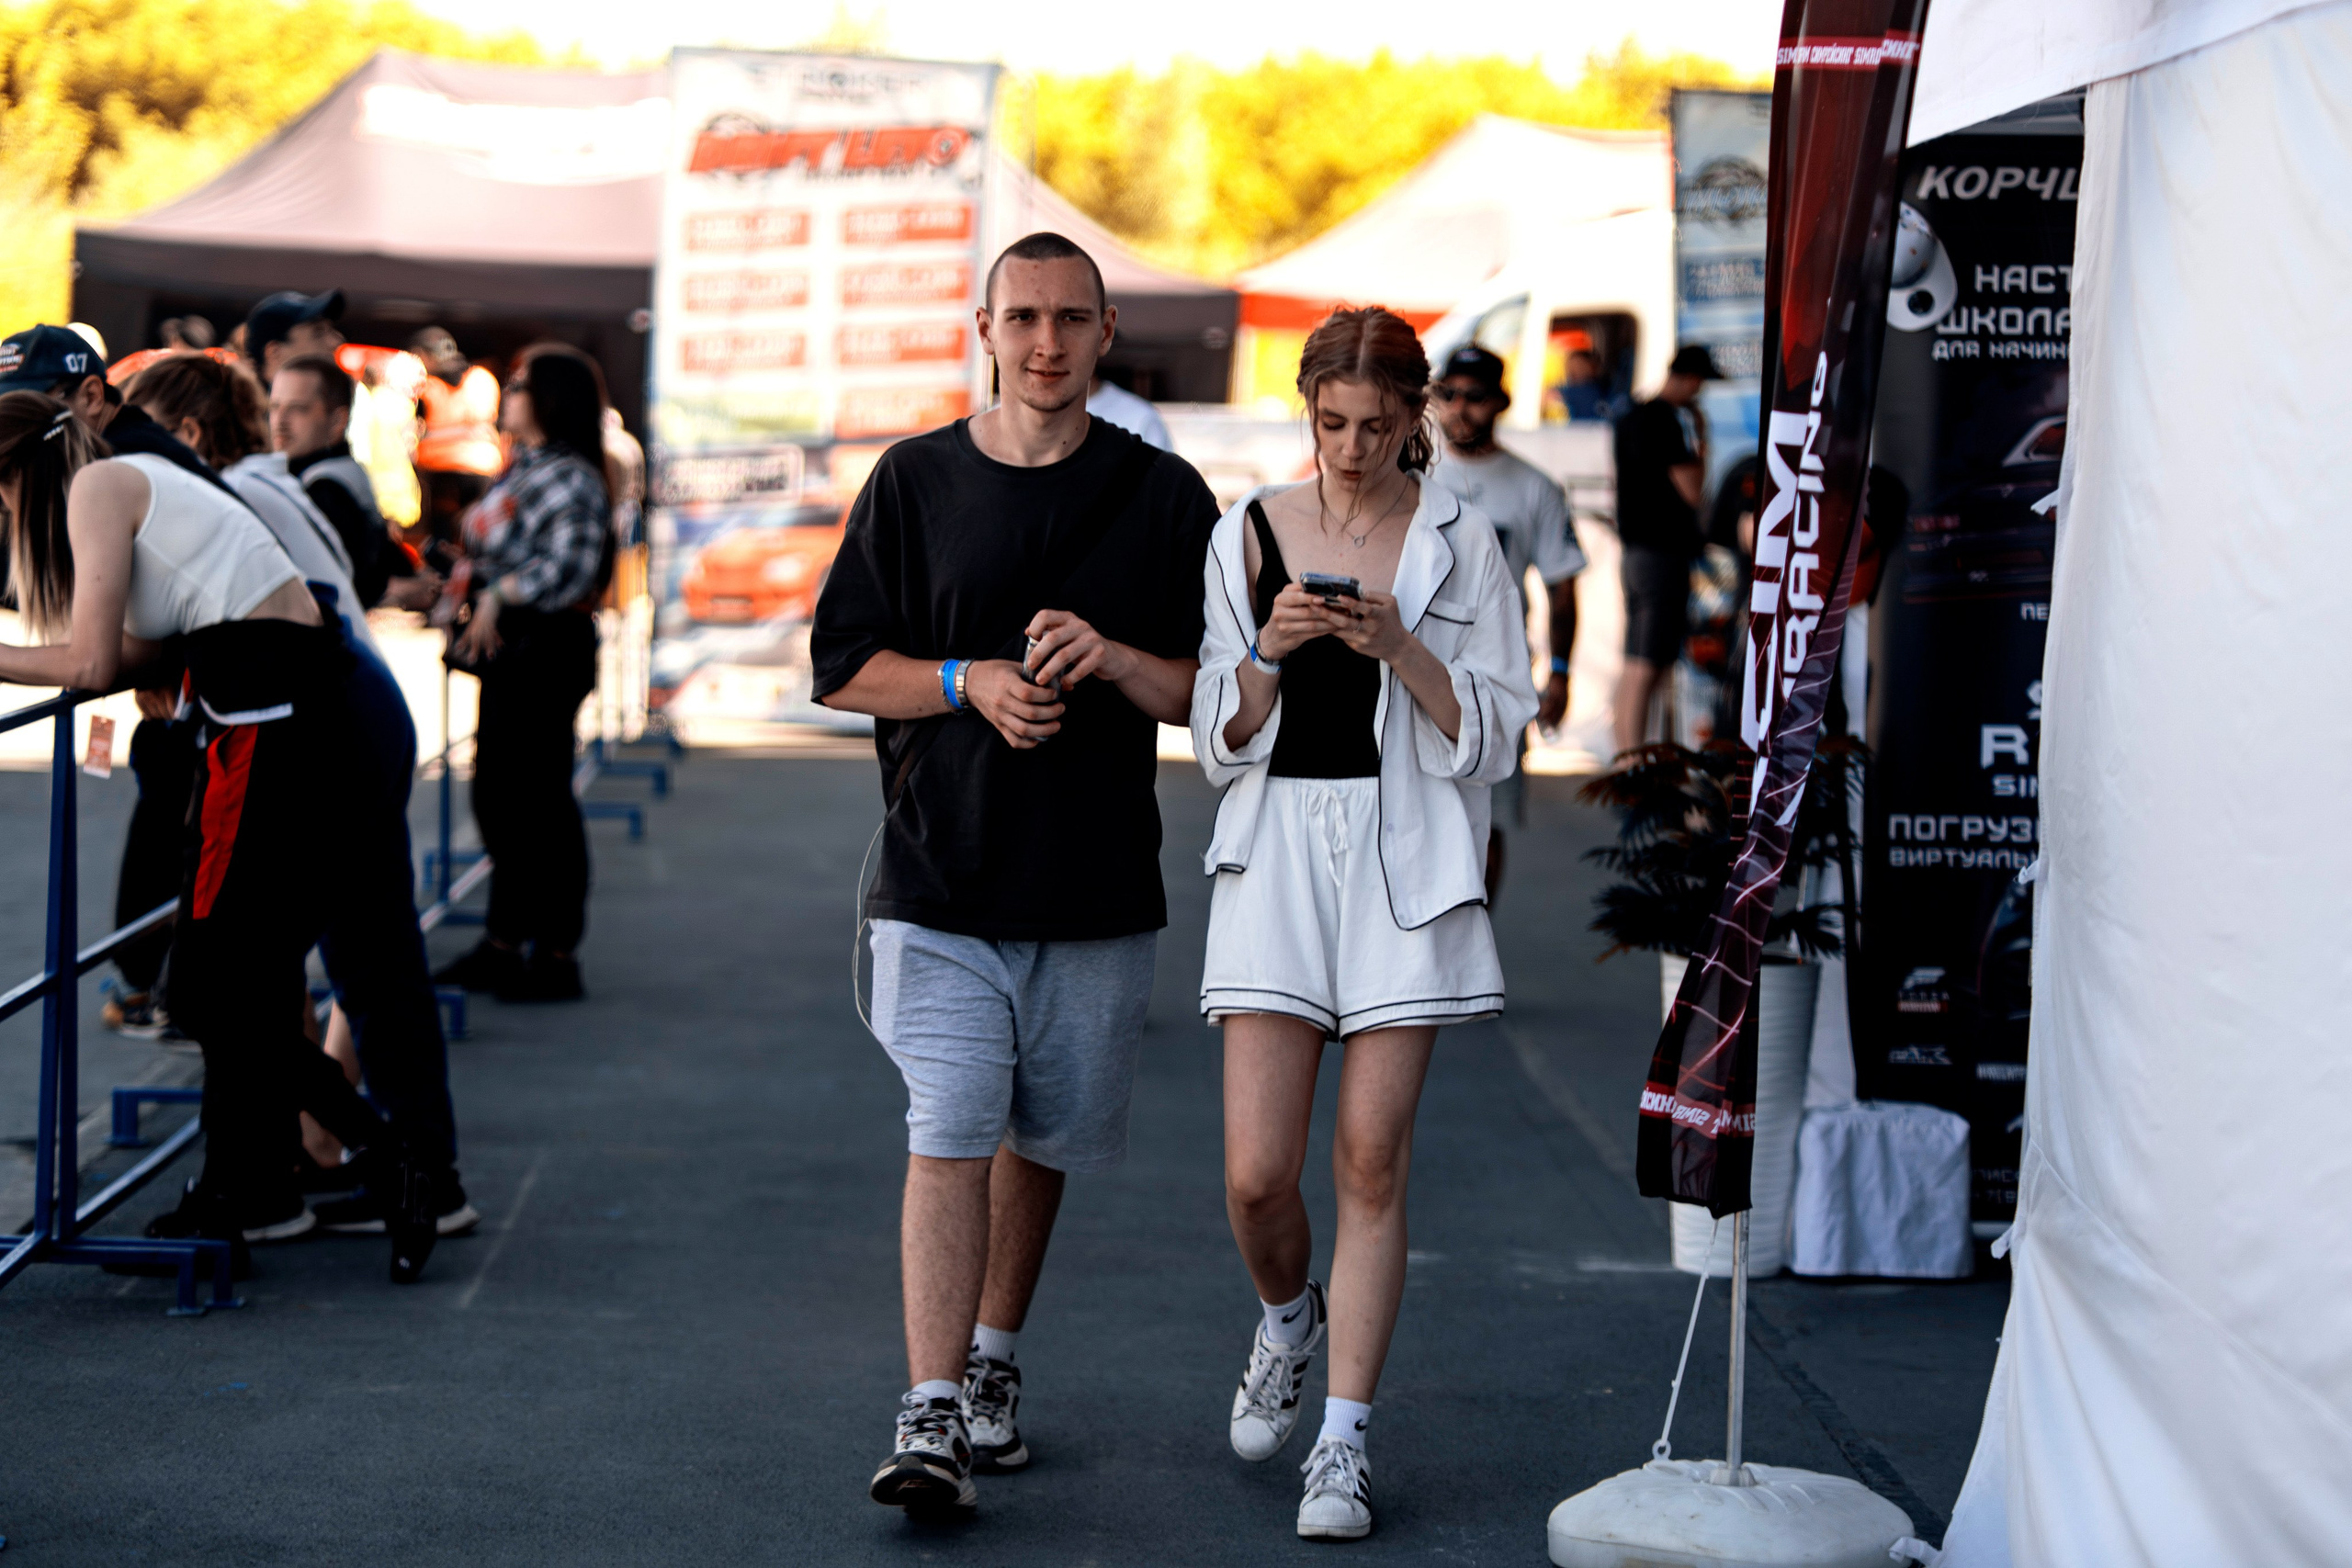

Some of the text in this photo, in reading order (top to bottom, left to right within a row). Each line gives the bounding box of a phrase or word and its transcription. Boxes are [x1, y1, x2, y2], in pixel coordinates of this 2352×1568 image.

[1931, 340, 2069, 361] ДЛЯ НАЧИН
[65, 352, 88, 374] 07
[1889, 814, 2039, 843] ПОГРУЗ
[1889, 846, 2037, 869] ВИРТУАЛЬ
